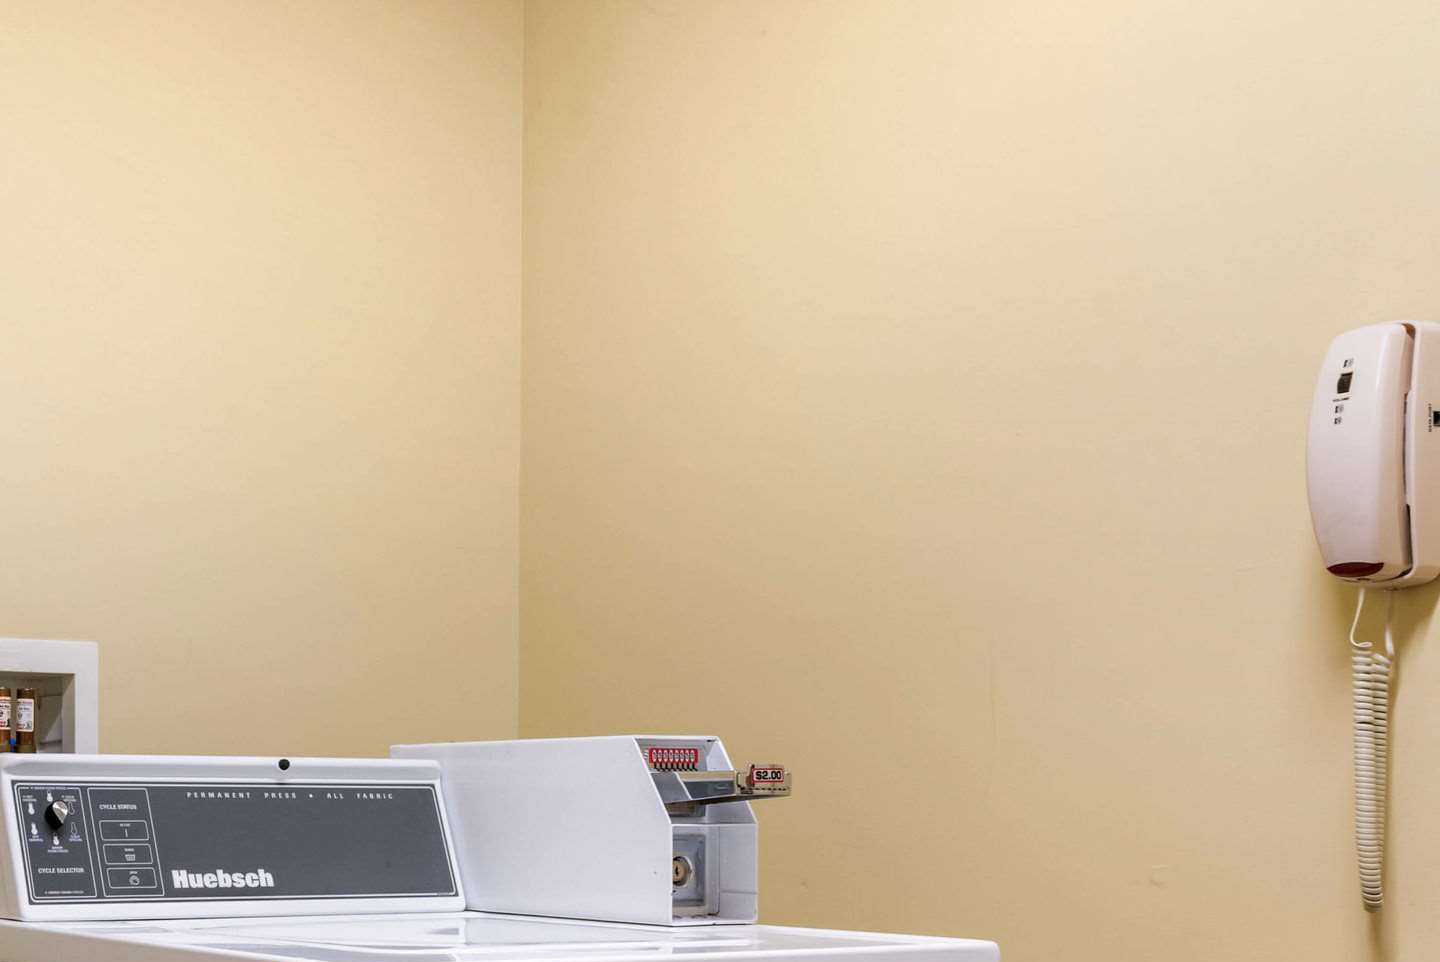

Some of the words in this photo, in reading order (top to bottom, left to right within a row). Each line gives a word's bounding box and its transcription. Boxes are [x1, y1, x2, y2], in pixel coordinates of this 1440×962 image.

[186, 791, 251, 799] PERMANENT
[326, 792, 345, 800] ALL
[171, 868, 275, 889] Huebsch
